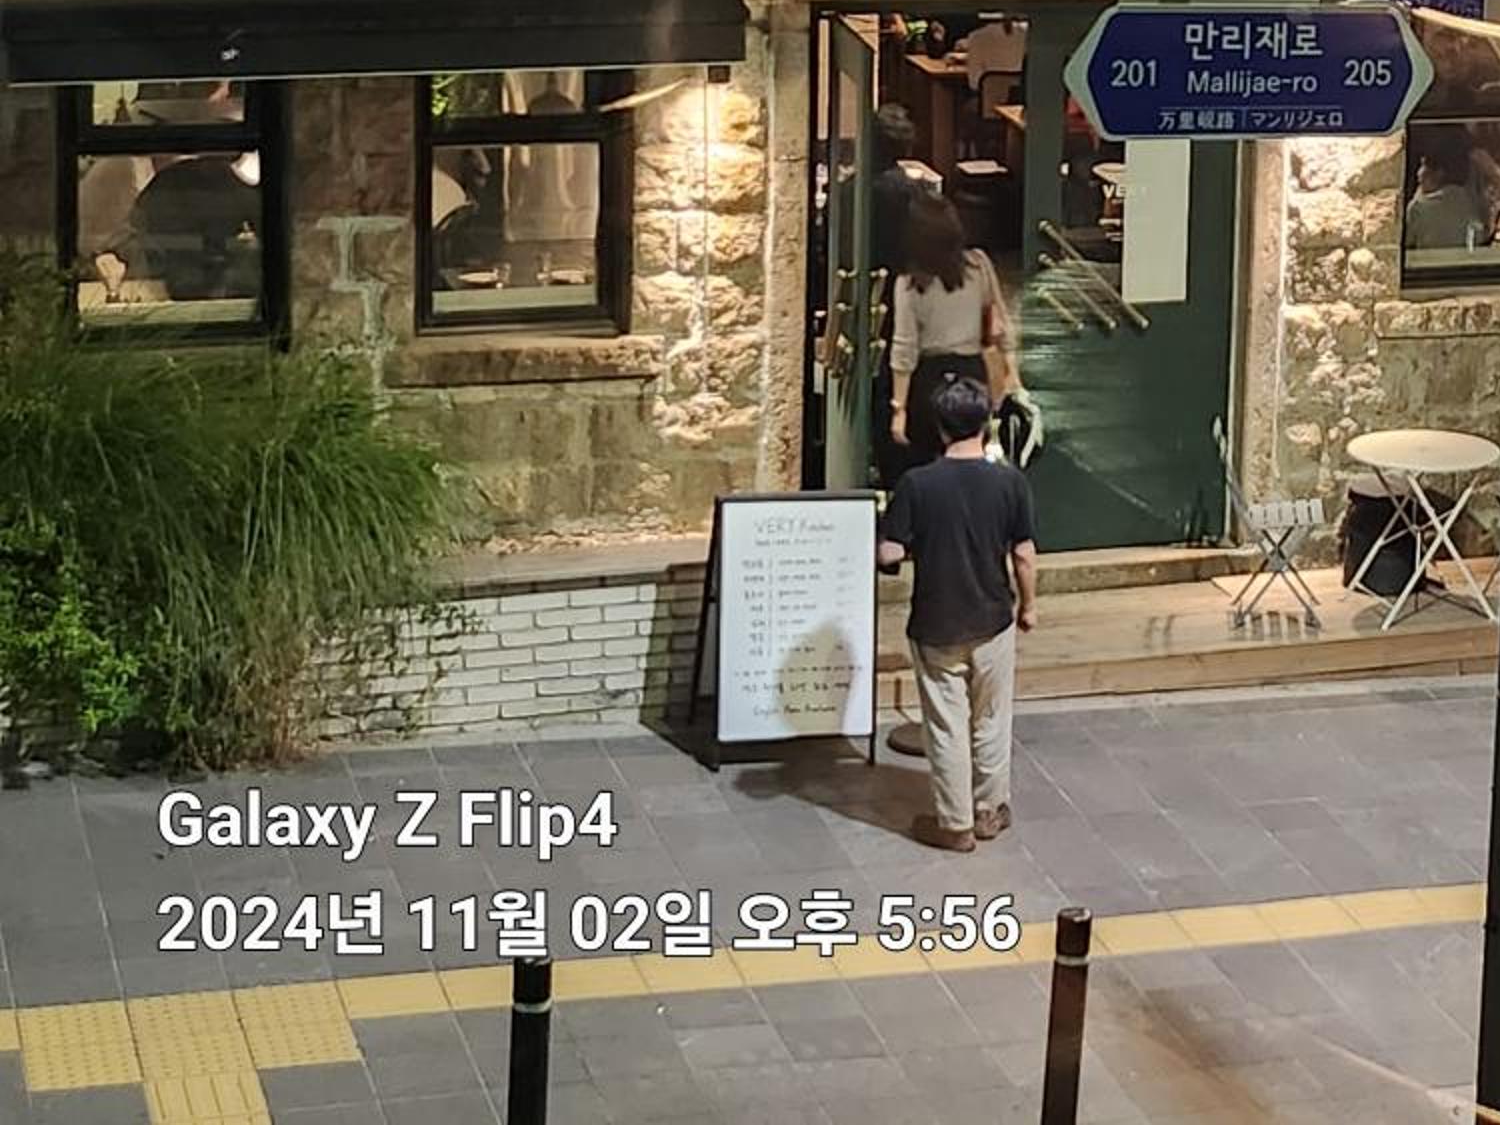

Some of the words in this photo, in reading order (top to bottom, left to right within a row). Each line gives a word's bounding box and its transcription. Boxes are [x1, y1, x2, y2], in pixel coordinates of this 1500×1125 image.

[1185, 20, 1324, 62] 만리재로
[1110, 59, 1158, 88] 201
[1186, 70, 1319, 99] Mallijae-ro
[1343, 59, 1392, 87] 205
